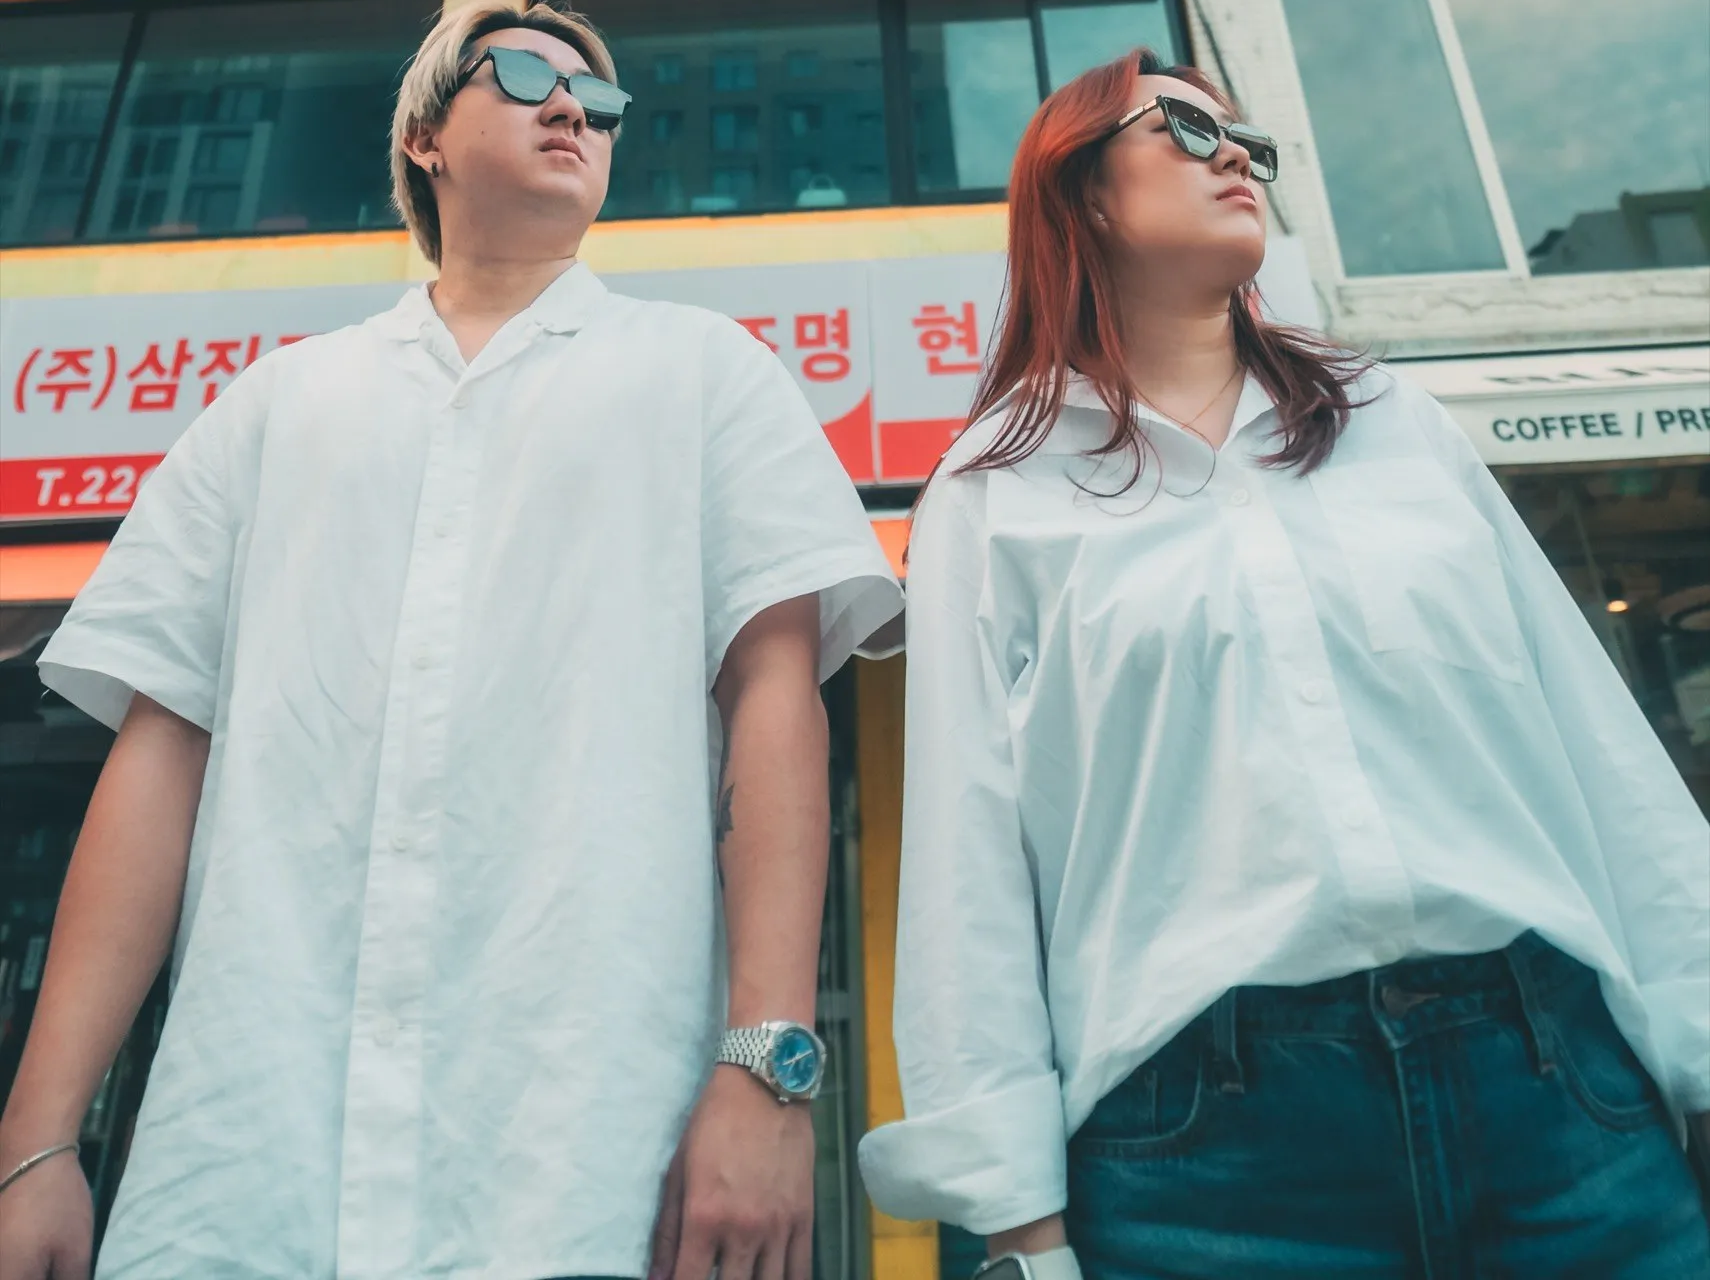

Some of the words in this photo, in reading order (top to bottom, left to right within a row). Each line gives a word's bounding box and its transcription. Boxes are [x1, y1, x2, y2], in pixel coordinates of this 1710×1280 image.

[13, 332, 327, 413] (주)삼진
[1492, 412, 1623, 442] COFFEE
[36, 464, 160, 507] T.22
